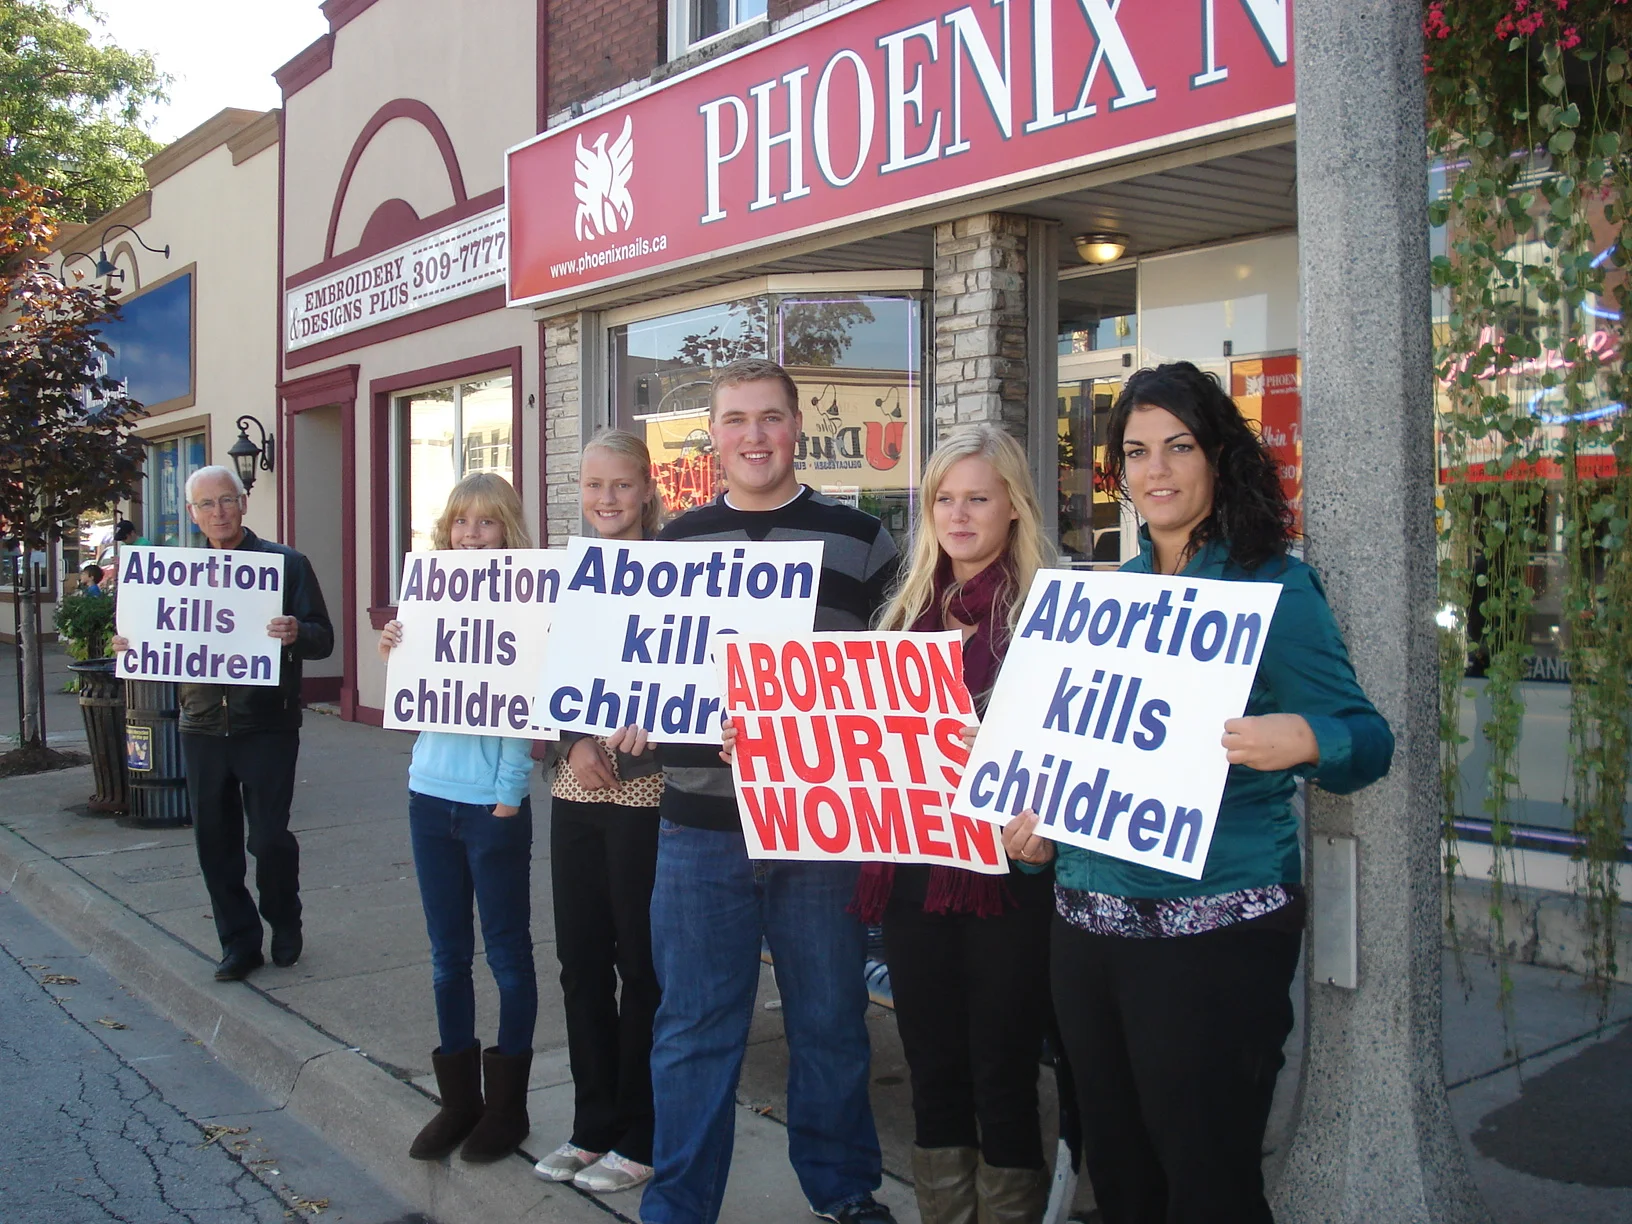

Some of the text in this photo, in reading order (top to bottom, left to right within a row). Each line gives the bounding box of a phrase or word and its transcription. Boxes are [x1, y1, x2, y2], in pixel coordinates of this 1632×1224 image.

[700, 0, 1157, 225] PHOENIX
[304, 255, 405, 313] EMBROIDERY
[412, 230, 506, 289] 309-7777
[550, 234, 667, 278] www.phoenixnails.ca
[289, 281, 409, 341] & DESIGNS PLUS
[123, 551, 279, 592] Abortion
[403, 555, 561, 604] Abortion
[567, 546, 814, 600] Abortion
[156, 597, 235, 634] kills
[434, 617, 517, 666] kills
[621, 614, 740, 665] kill
[1021, 579, 1262, 666] Abortion
[123, 641, 272, 680] children
[726, 639, 972, 715] ABORTION
[394, 678, 552, 732] childre
[549, 678, 729, 735] childr
[1042, 667, 1172, 751] kills
[733, 714, 973, 789] HURTS
[741, 785, 999, 866] WOMEN
[969, 749, 1204, 864] children
